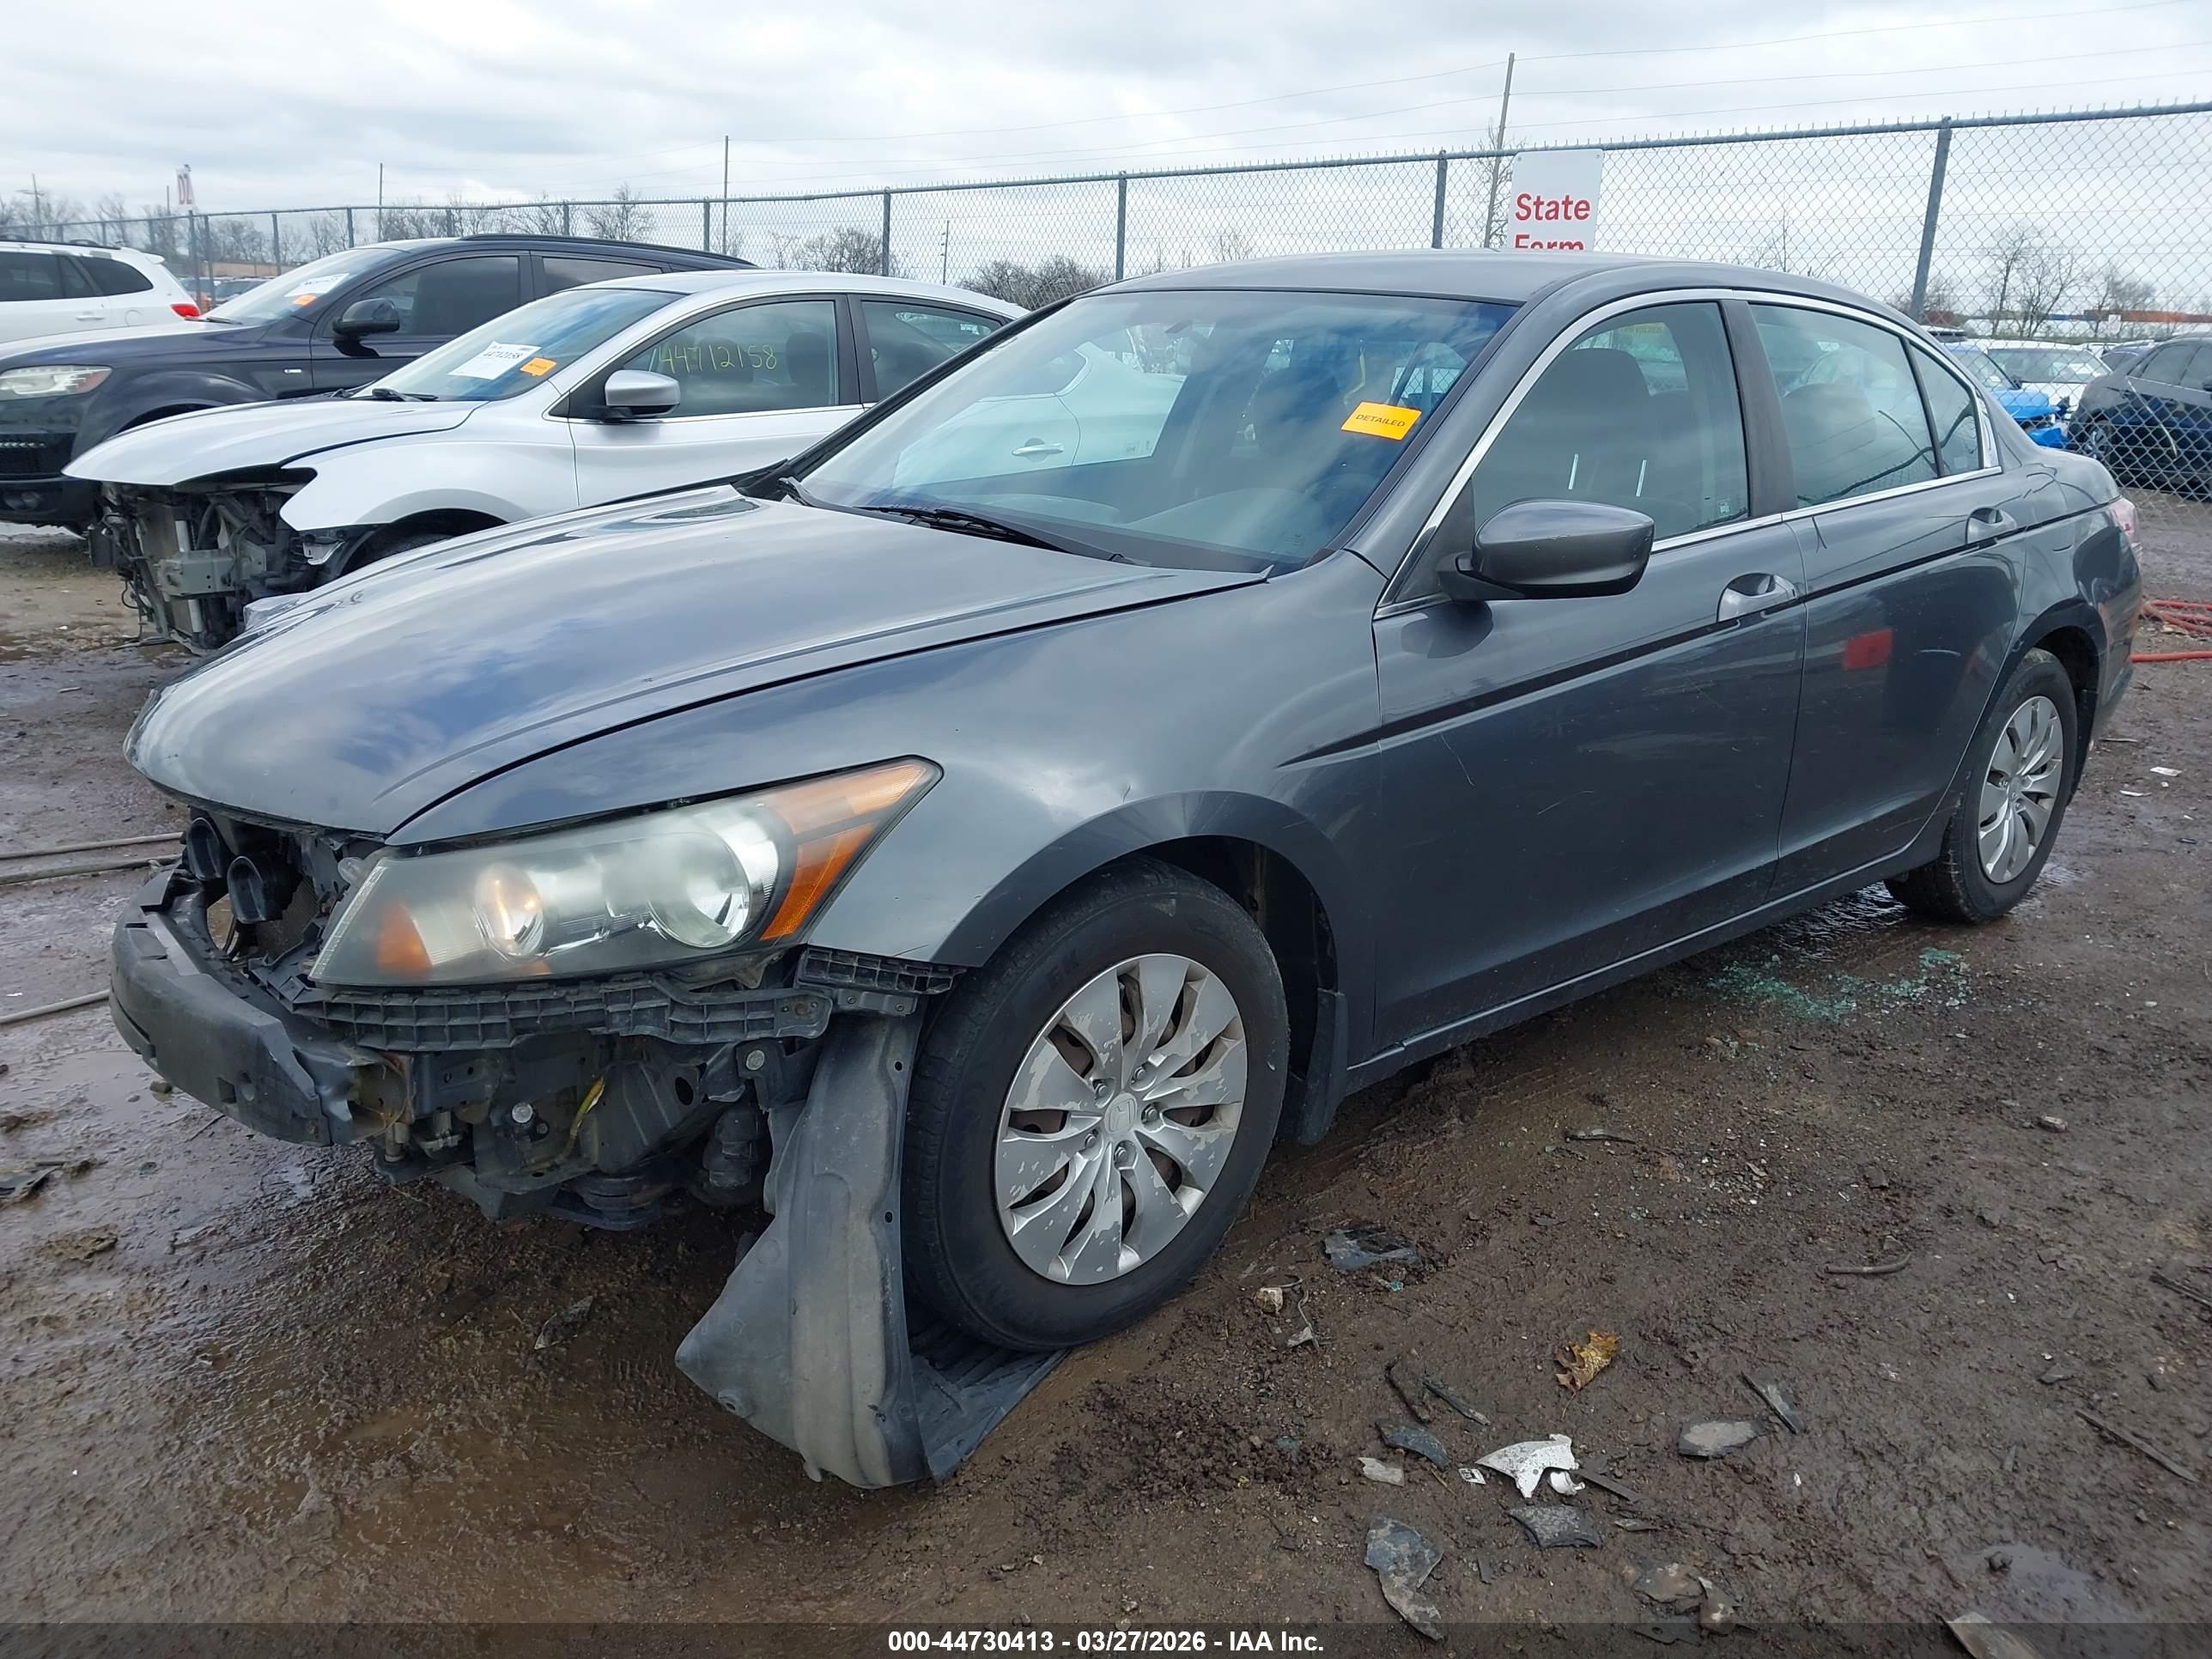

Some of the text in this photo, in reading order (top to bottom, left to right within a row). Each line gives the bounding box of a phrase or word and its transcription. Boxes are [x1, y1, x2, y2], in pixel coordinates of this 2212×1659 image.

[1515, 192, 1591, 221] State
[659, 344, 777, 374] 44712158
[1355, 414, 1406, 427] DETAILED
